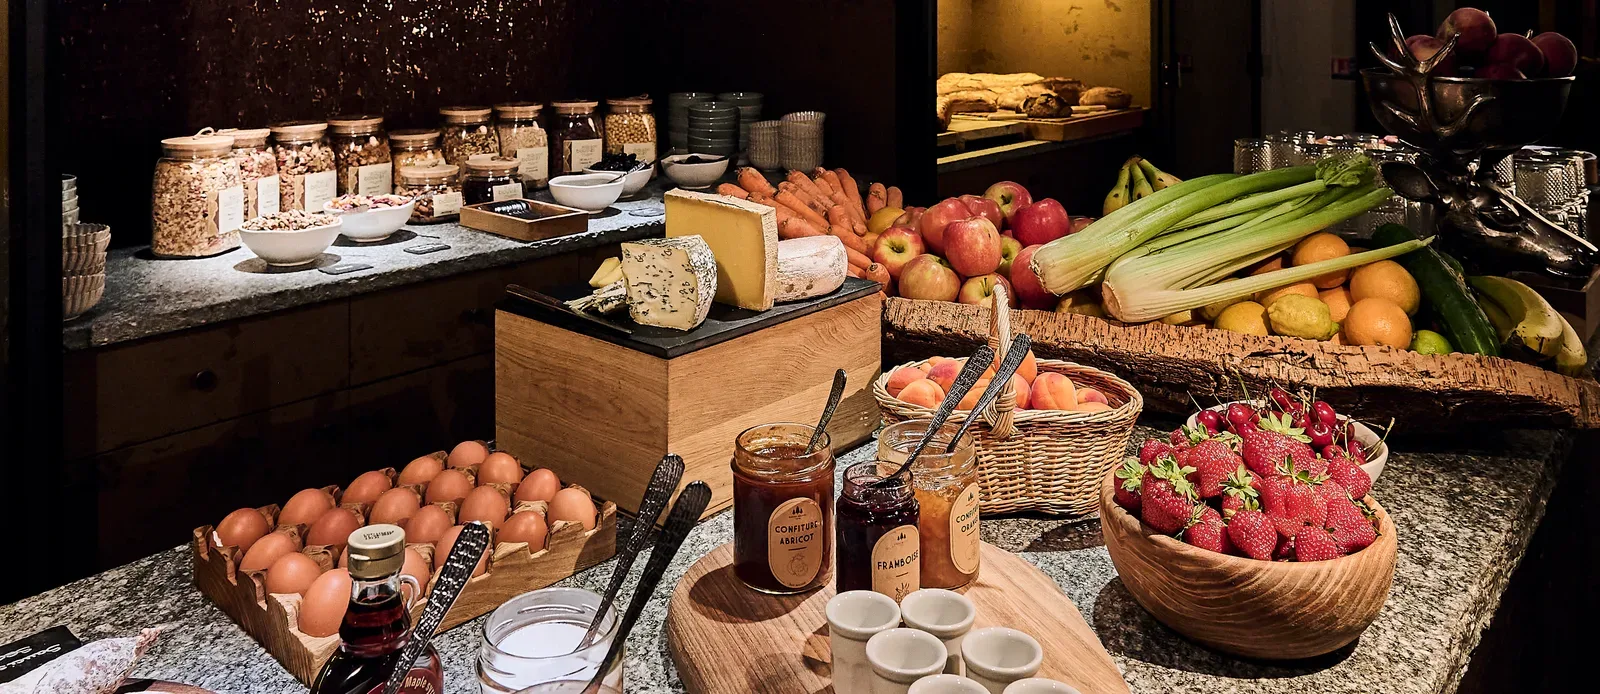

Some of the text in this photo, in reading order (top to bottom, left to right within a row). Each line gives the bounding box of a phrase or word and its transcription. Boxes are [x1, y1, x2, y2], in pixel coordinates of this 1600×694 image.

[775, 520, 818, 533] CONFITURE
[780, 533, 814, 545] ABRICOT
[877, 549, 918, 570] FRAMBOISE
[404, 676, 427, 689] Maple
